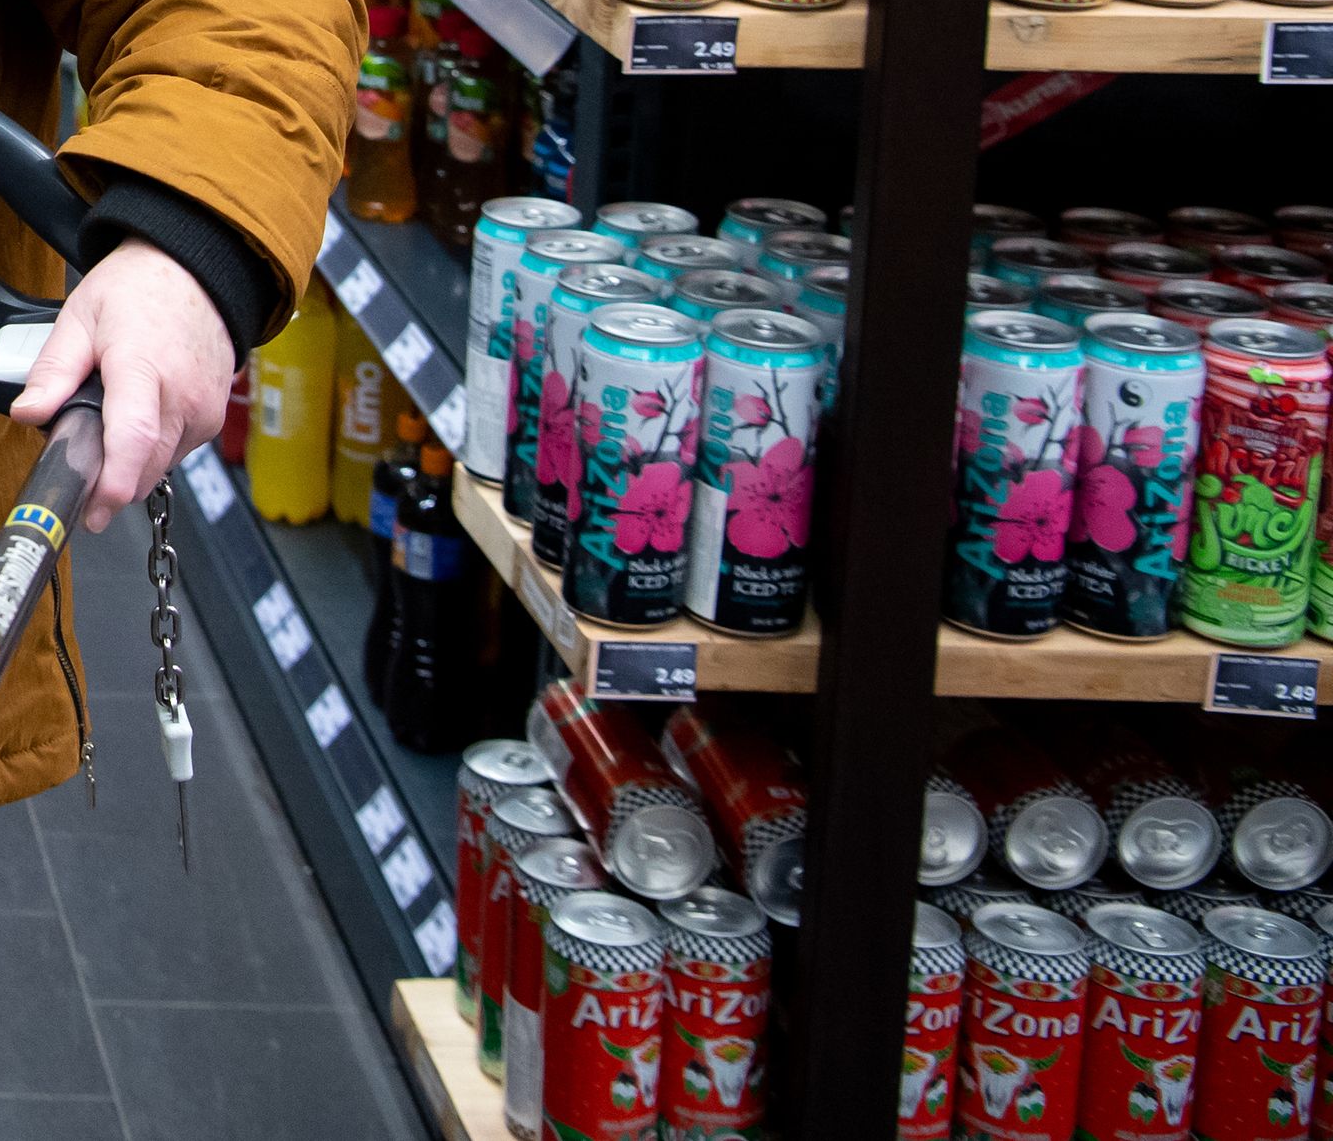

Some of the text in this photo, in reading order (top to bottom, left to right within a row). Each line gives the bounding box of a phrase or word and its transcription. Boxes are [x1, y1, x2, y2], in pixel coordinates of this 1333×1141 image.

[693, 41, 736, 58] 2.49
[1133, 401, 1190, 583] AriZona
[654, 667, 696, 685] 2.49
[1275, 683, 1316, 701] 2.49
[571, 992, 664, 1031] AriZ
